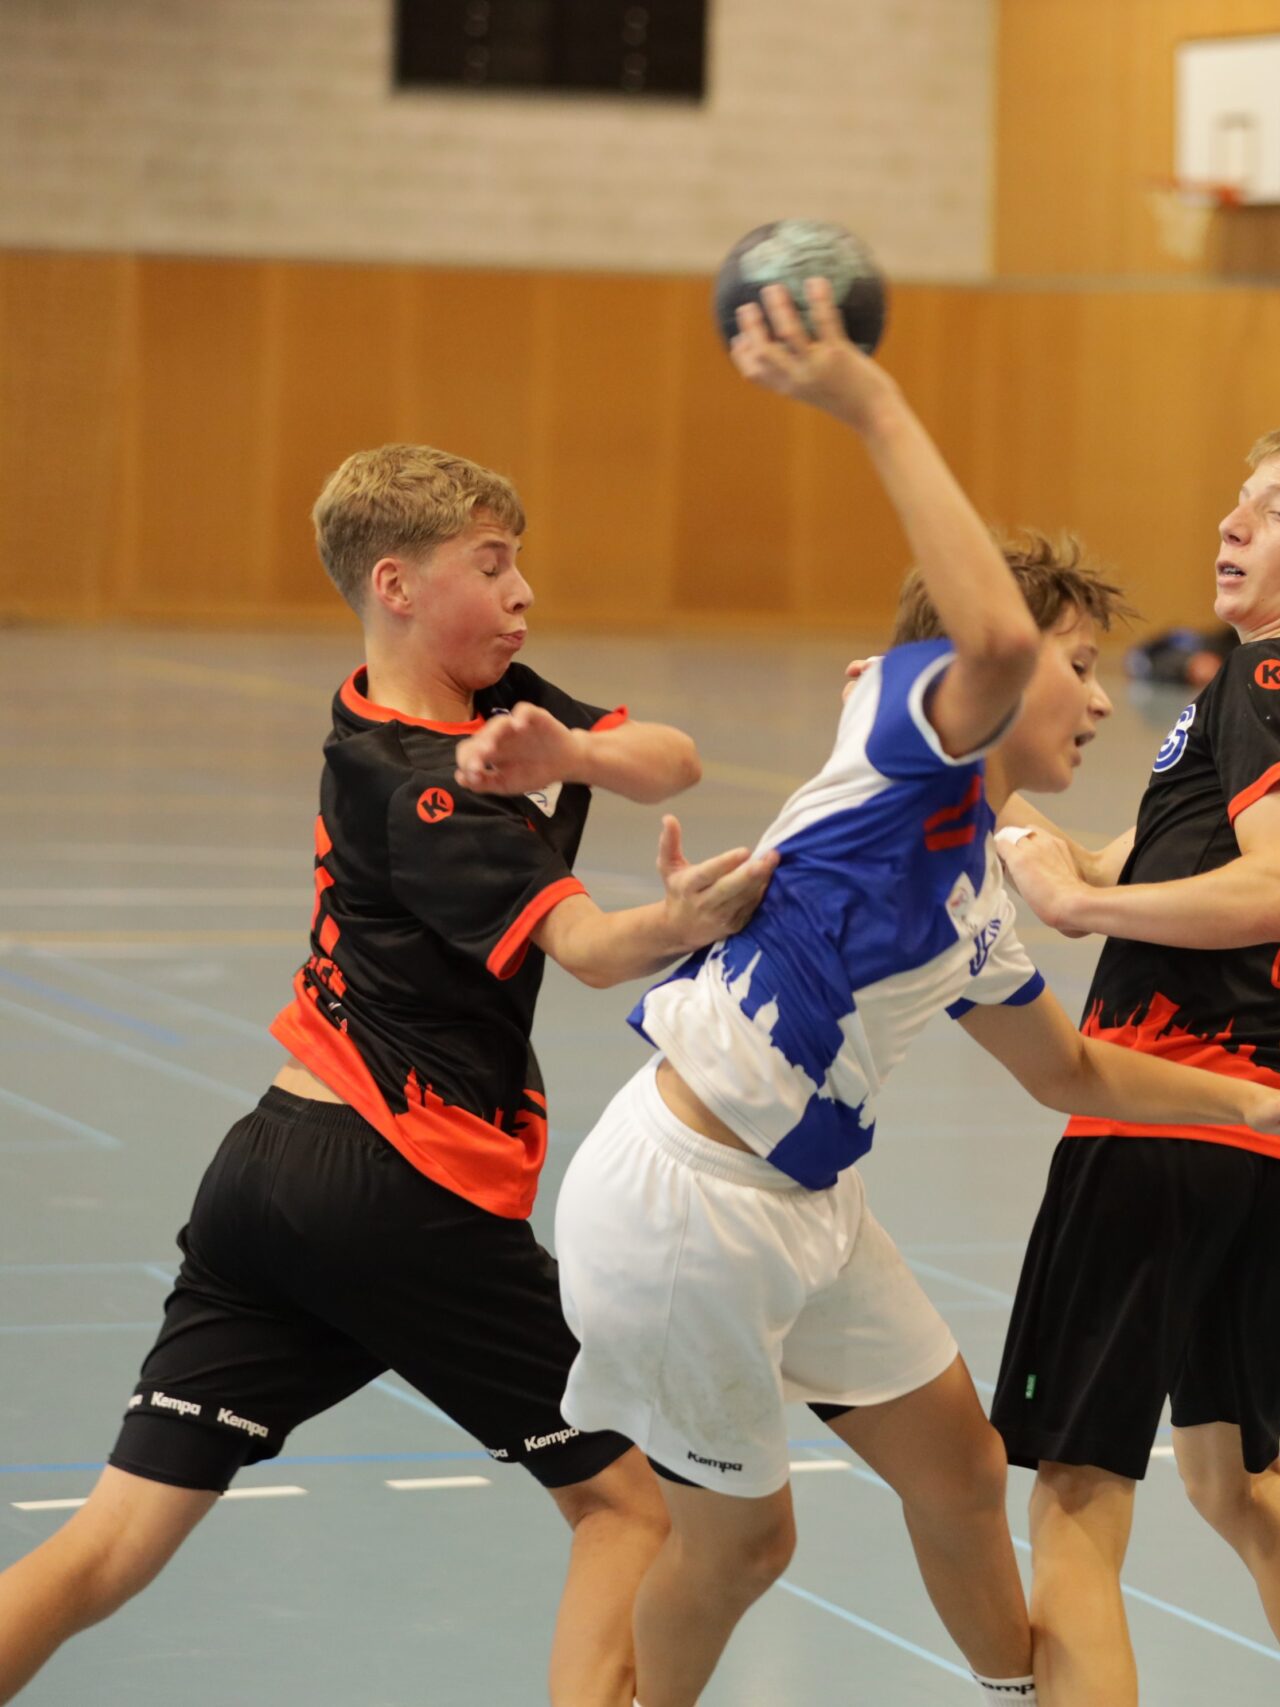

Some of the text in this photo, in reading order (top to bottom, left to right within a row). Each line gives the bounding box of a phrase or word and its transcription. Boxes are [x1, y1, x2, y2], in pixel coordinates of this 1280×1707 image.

[151, 1391, 202, 1416] Kempa
[217, 1407, 269, 1438] Kempa
[524, 1426, 580, 1452] Kempa
[687, 1450, 743, 1474] Kempa
